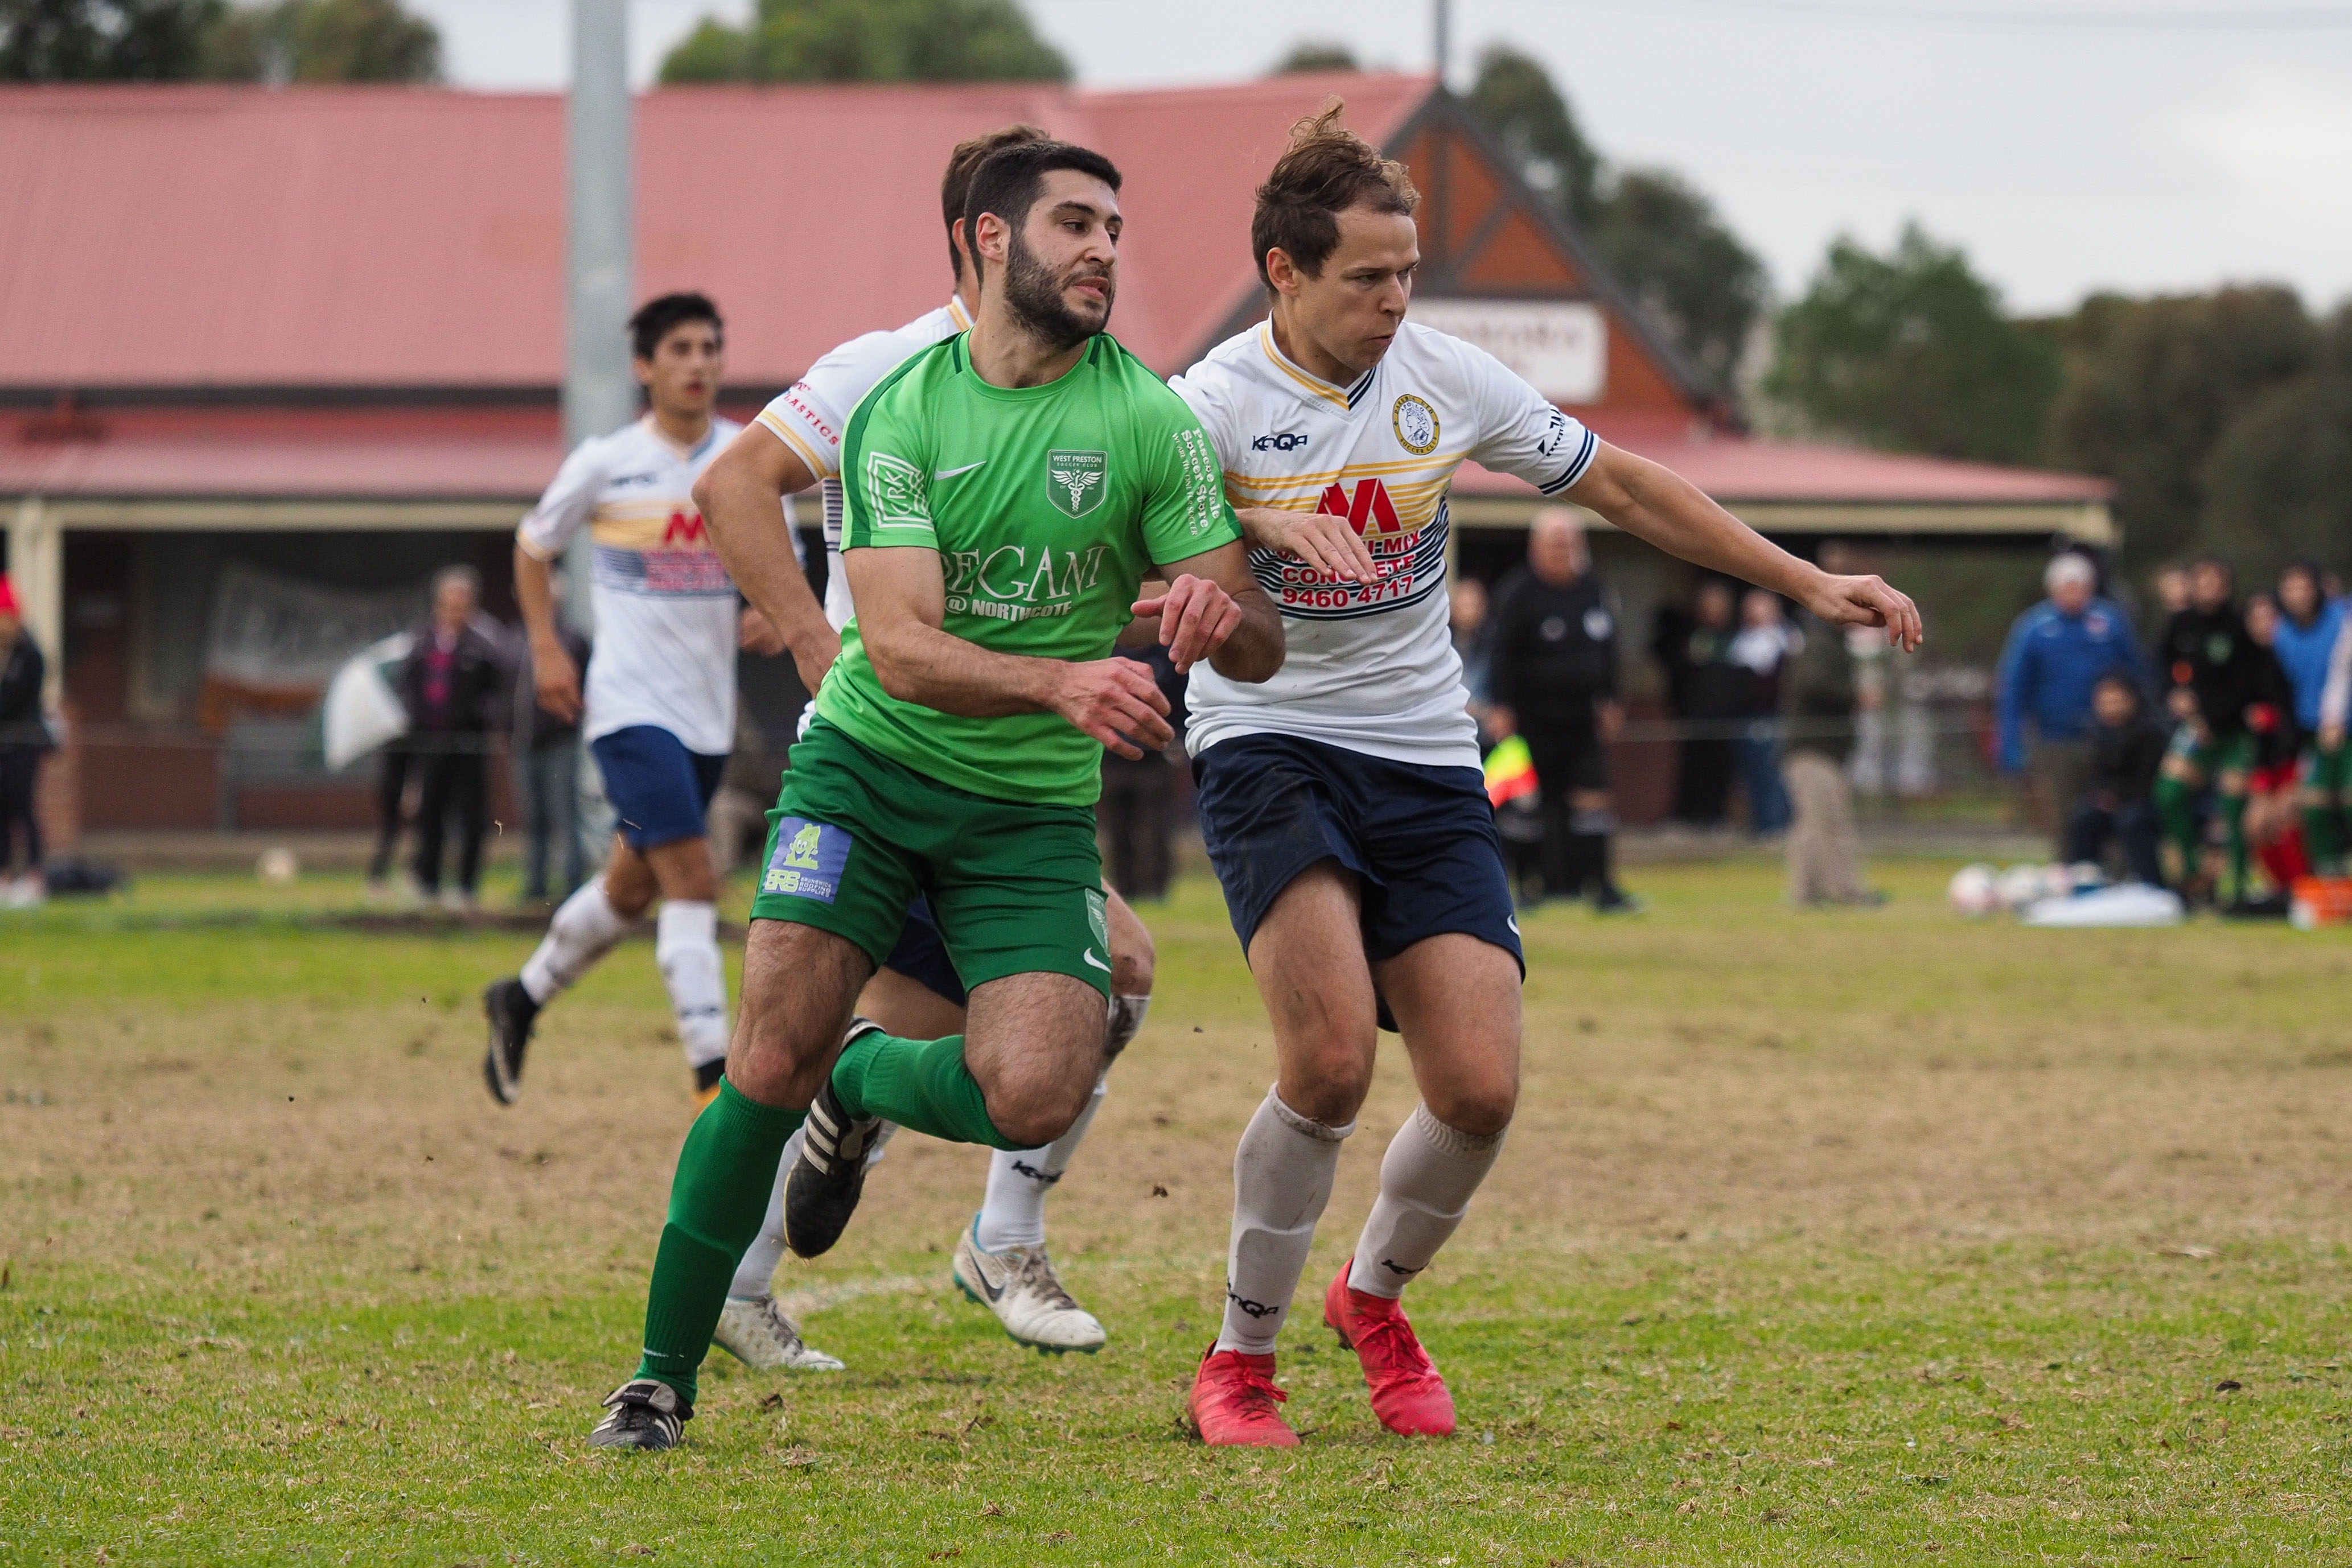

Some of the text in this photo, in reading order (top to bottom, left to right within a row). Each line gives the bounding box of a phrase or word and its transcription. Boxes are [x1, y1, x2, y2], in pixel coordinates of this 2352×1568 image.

[1208, 484, 1221, 519] Vale
[1282, 574, 1415, 608] 9460 4717
[971, 599, 1072, 622] NORTHCOTE
[798, 886, 830, 898] SUPPLIES
[799, 882, 831, 894] ROOFING
